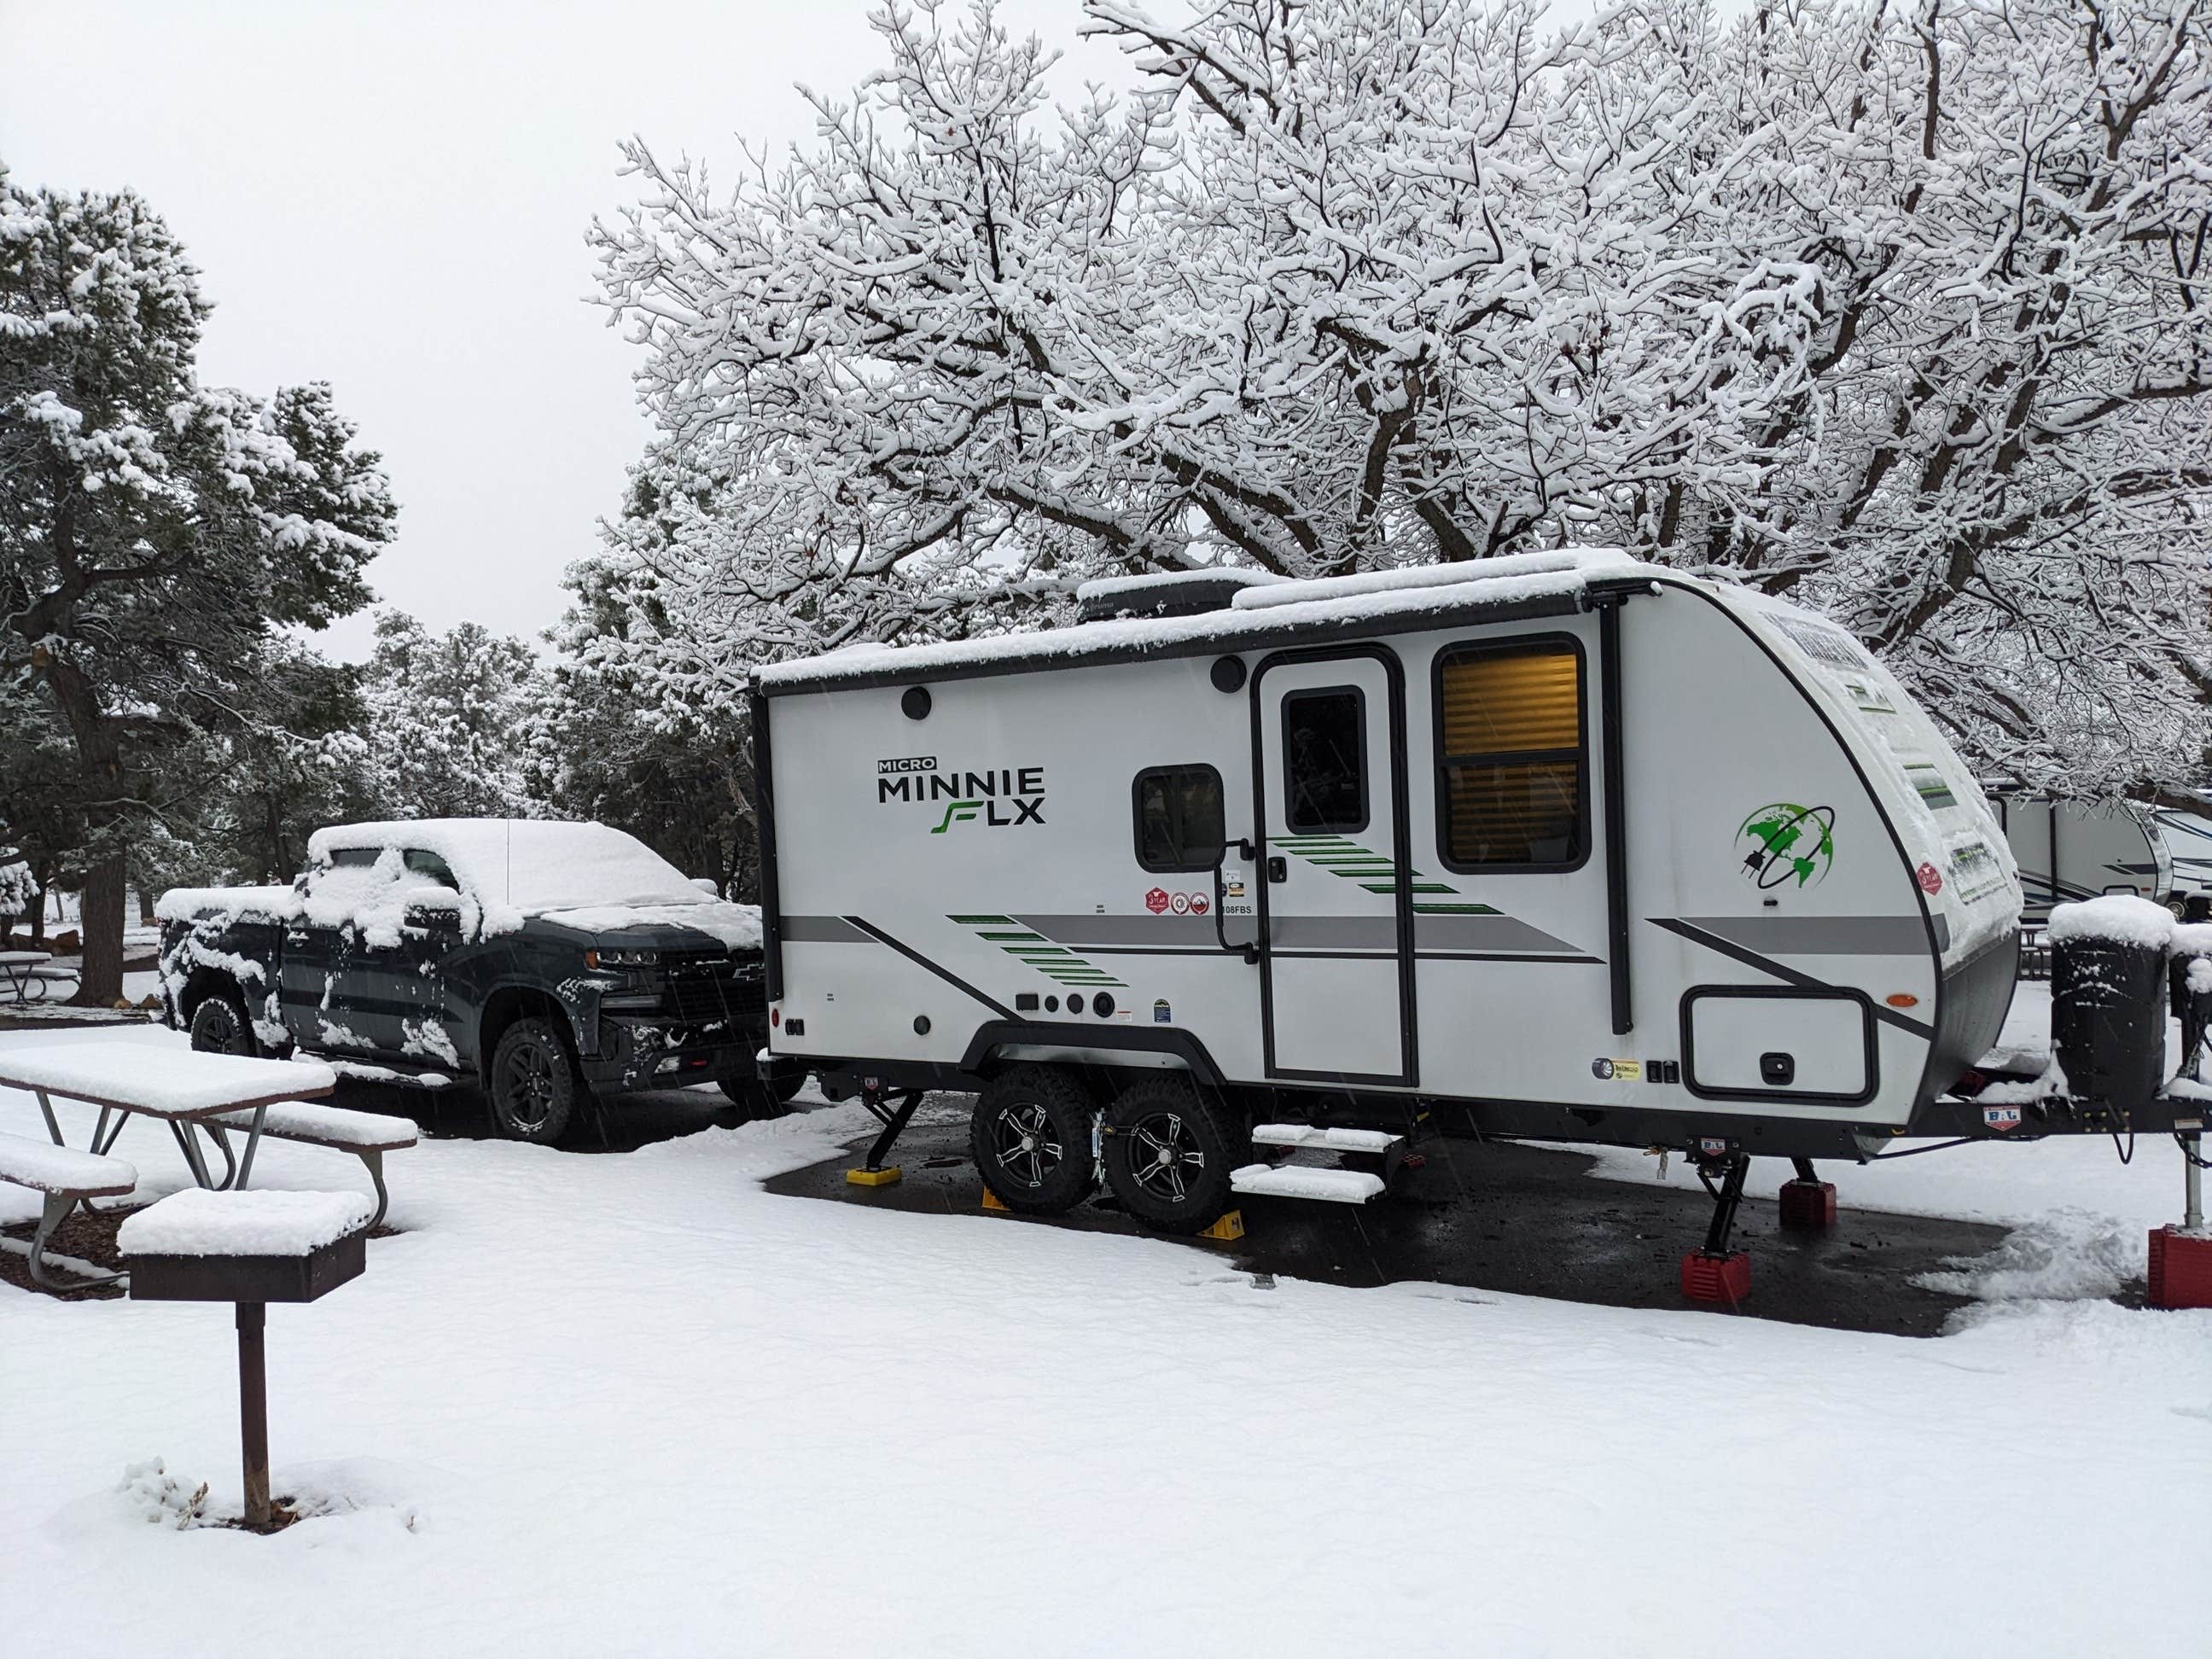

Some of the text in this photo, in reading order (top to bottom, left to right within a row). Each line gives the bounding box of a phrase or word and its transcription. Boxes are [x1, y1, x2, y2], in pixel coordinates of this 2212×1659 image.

[878, 758, 935, 772] MICRO
[878, 767, 1045, 803] MINNIE
[930, 797, 1046, 834] FLX
